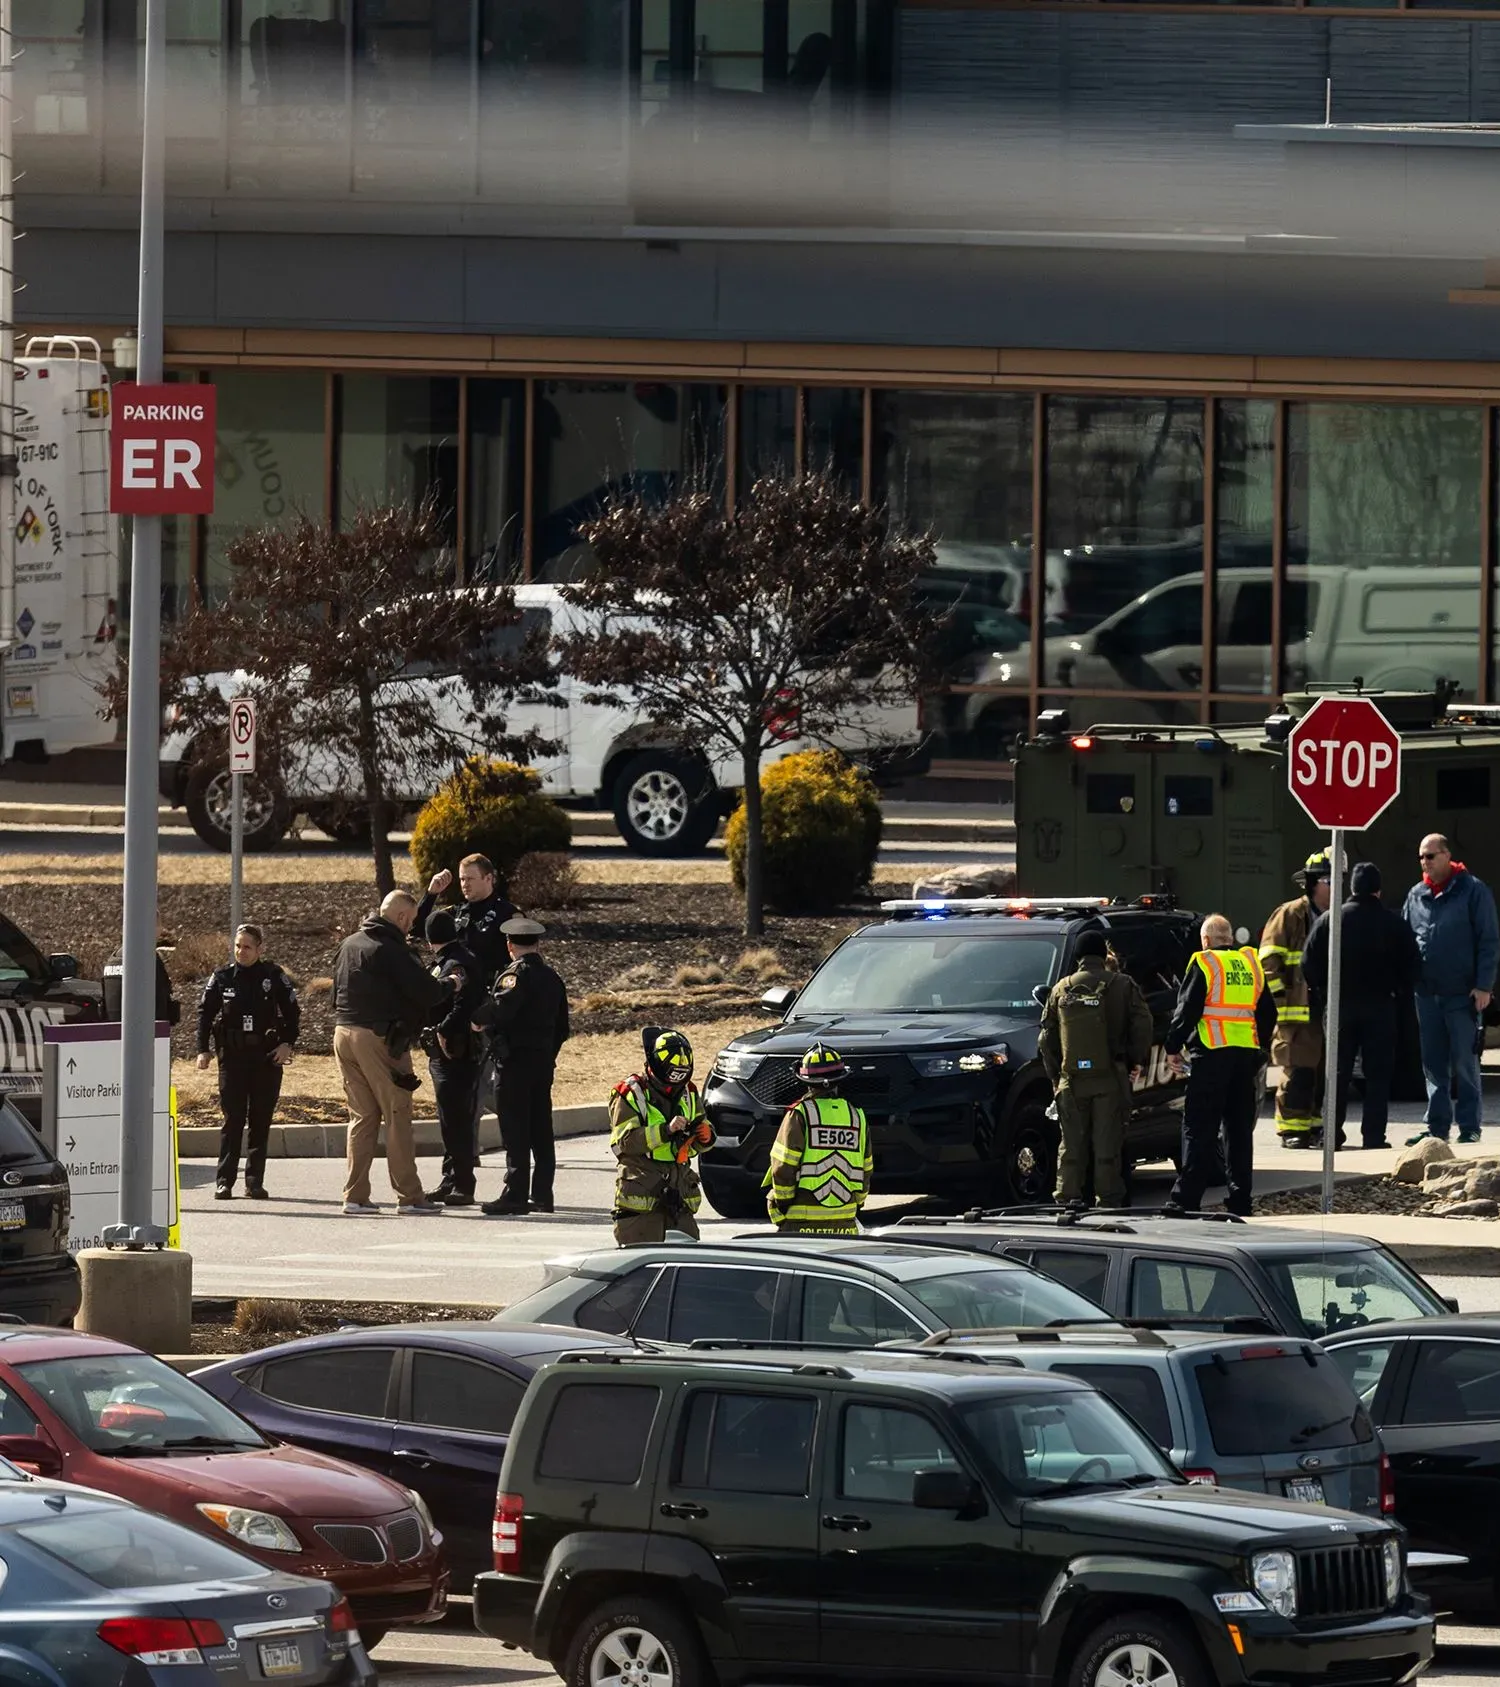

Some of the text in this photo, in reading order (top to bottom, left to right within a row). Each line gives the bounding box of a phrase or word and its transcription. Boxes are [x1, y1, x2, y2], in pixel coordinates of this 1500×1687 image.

[123, 405, 204, 420] PARKING
[122, 439, 202, 489] ER
[27, 478, 47, 498] OF
[43, 496, 64, 556] YORK
[1296, 738, 1393, 788] STOP
[1226, 971, 1241, 986] EMS
[66, 1083, 122, 1099] Visitor Parki
[817, 1129, 855, 1146] E502
[66, 1161, 120, 1176] Main Entran
[82, 1238, 92, 1249] to
